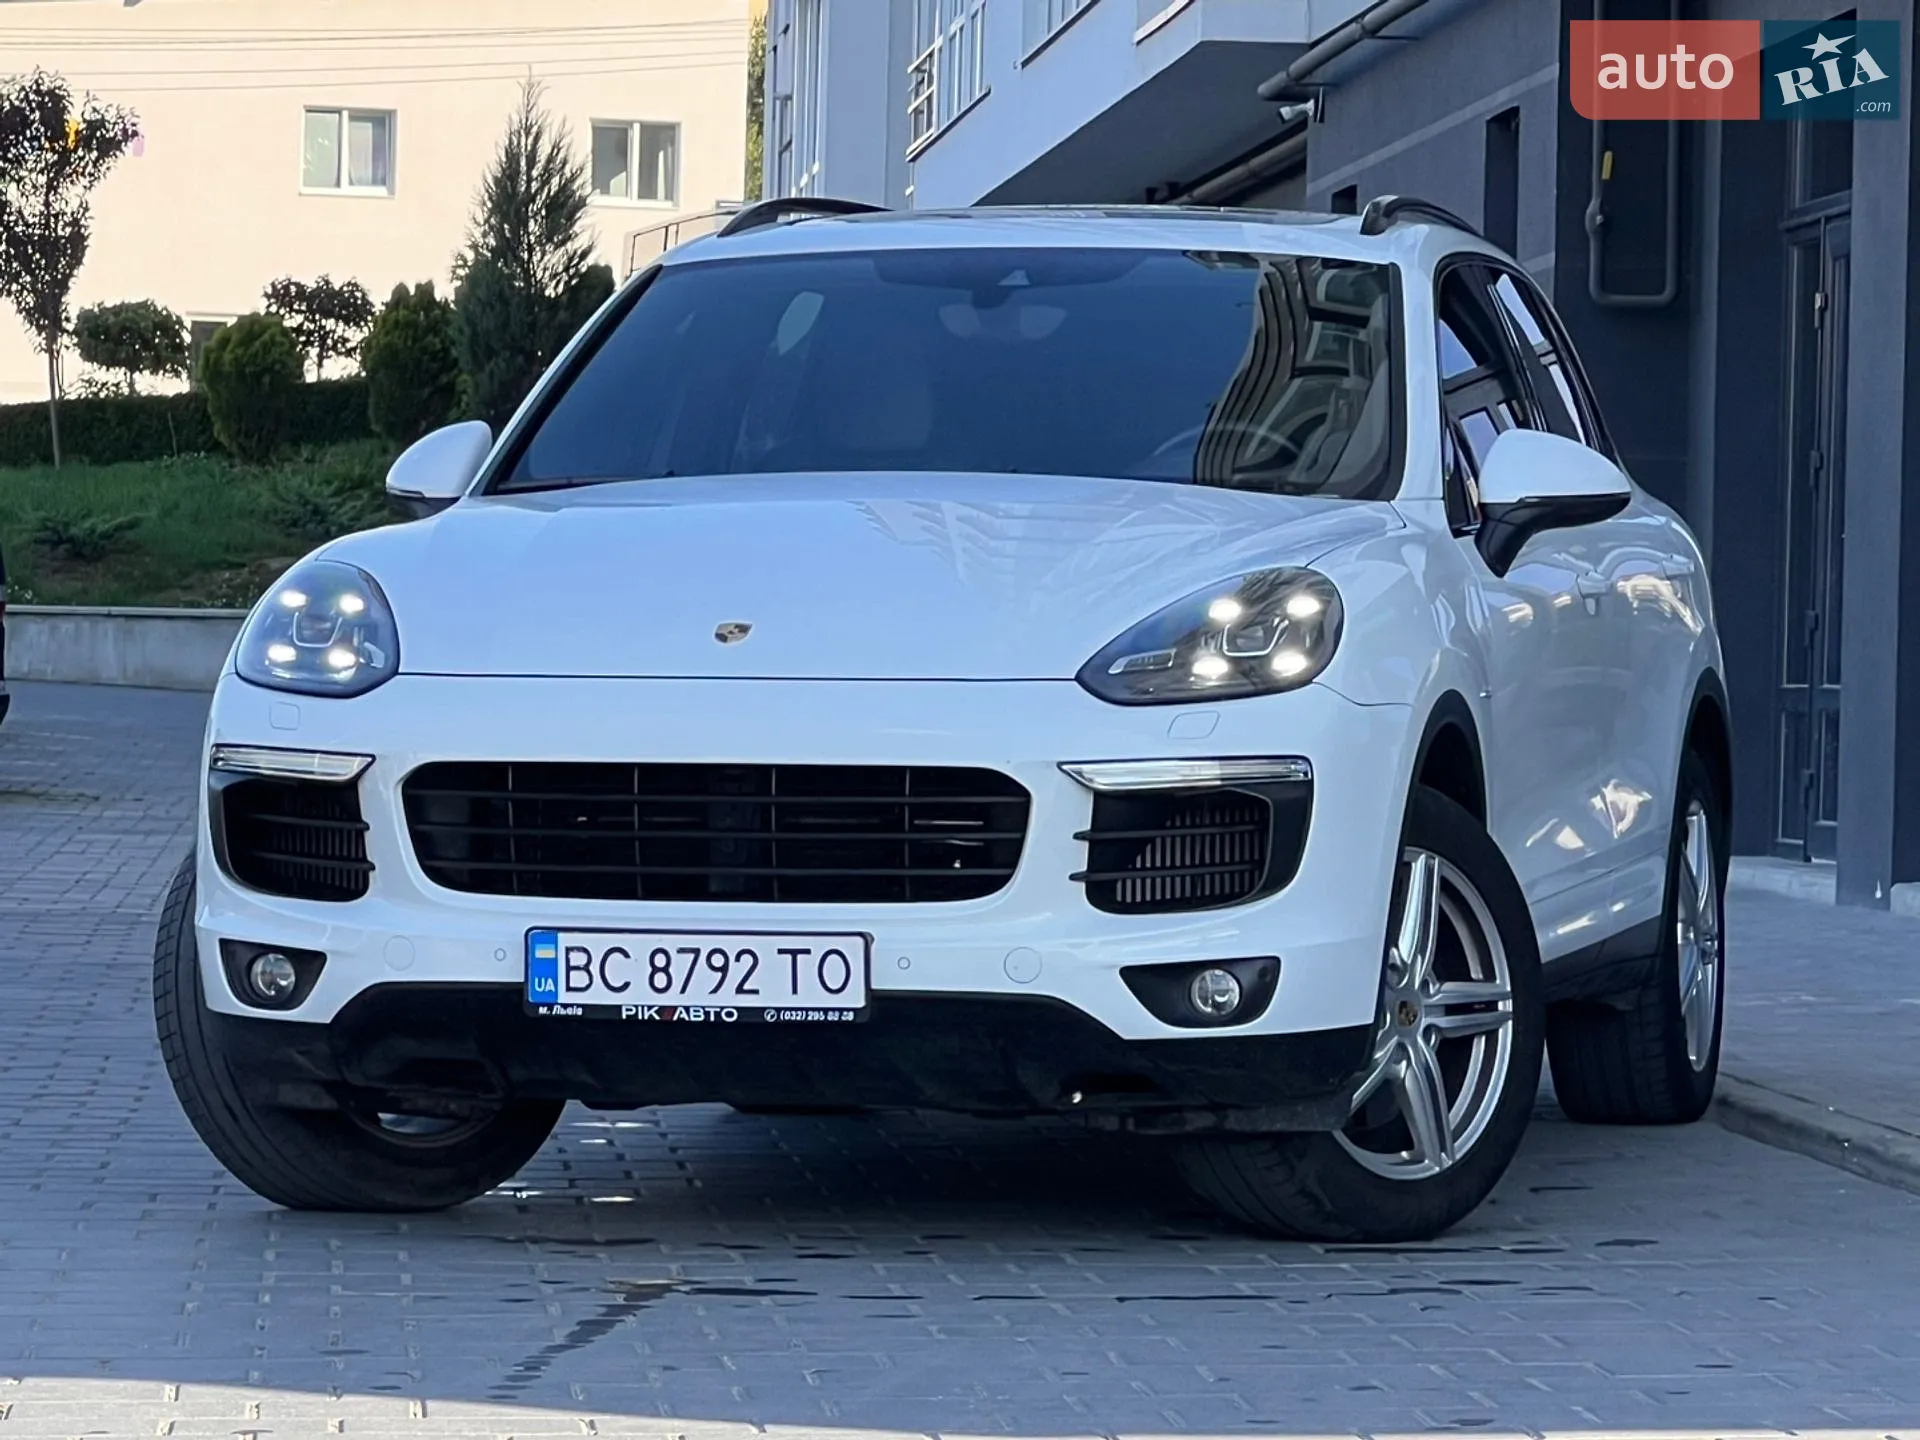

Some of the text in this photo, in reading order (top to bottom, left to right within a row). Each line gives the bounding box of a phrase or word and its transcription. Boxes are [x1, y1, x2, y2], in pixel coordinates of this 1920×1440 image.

[535, 978, 555, 992] UA
[565, 946, 851, 995] BC 8792 TO
